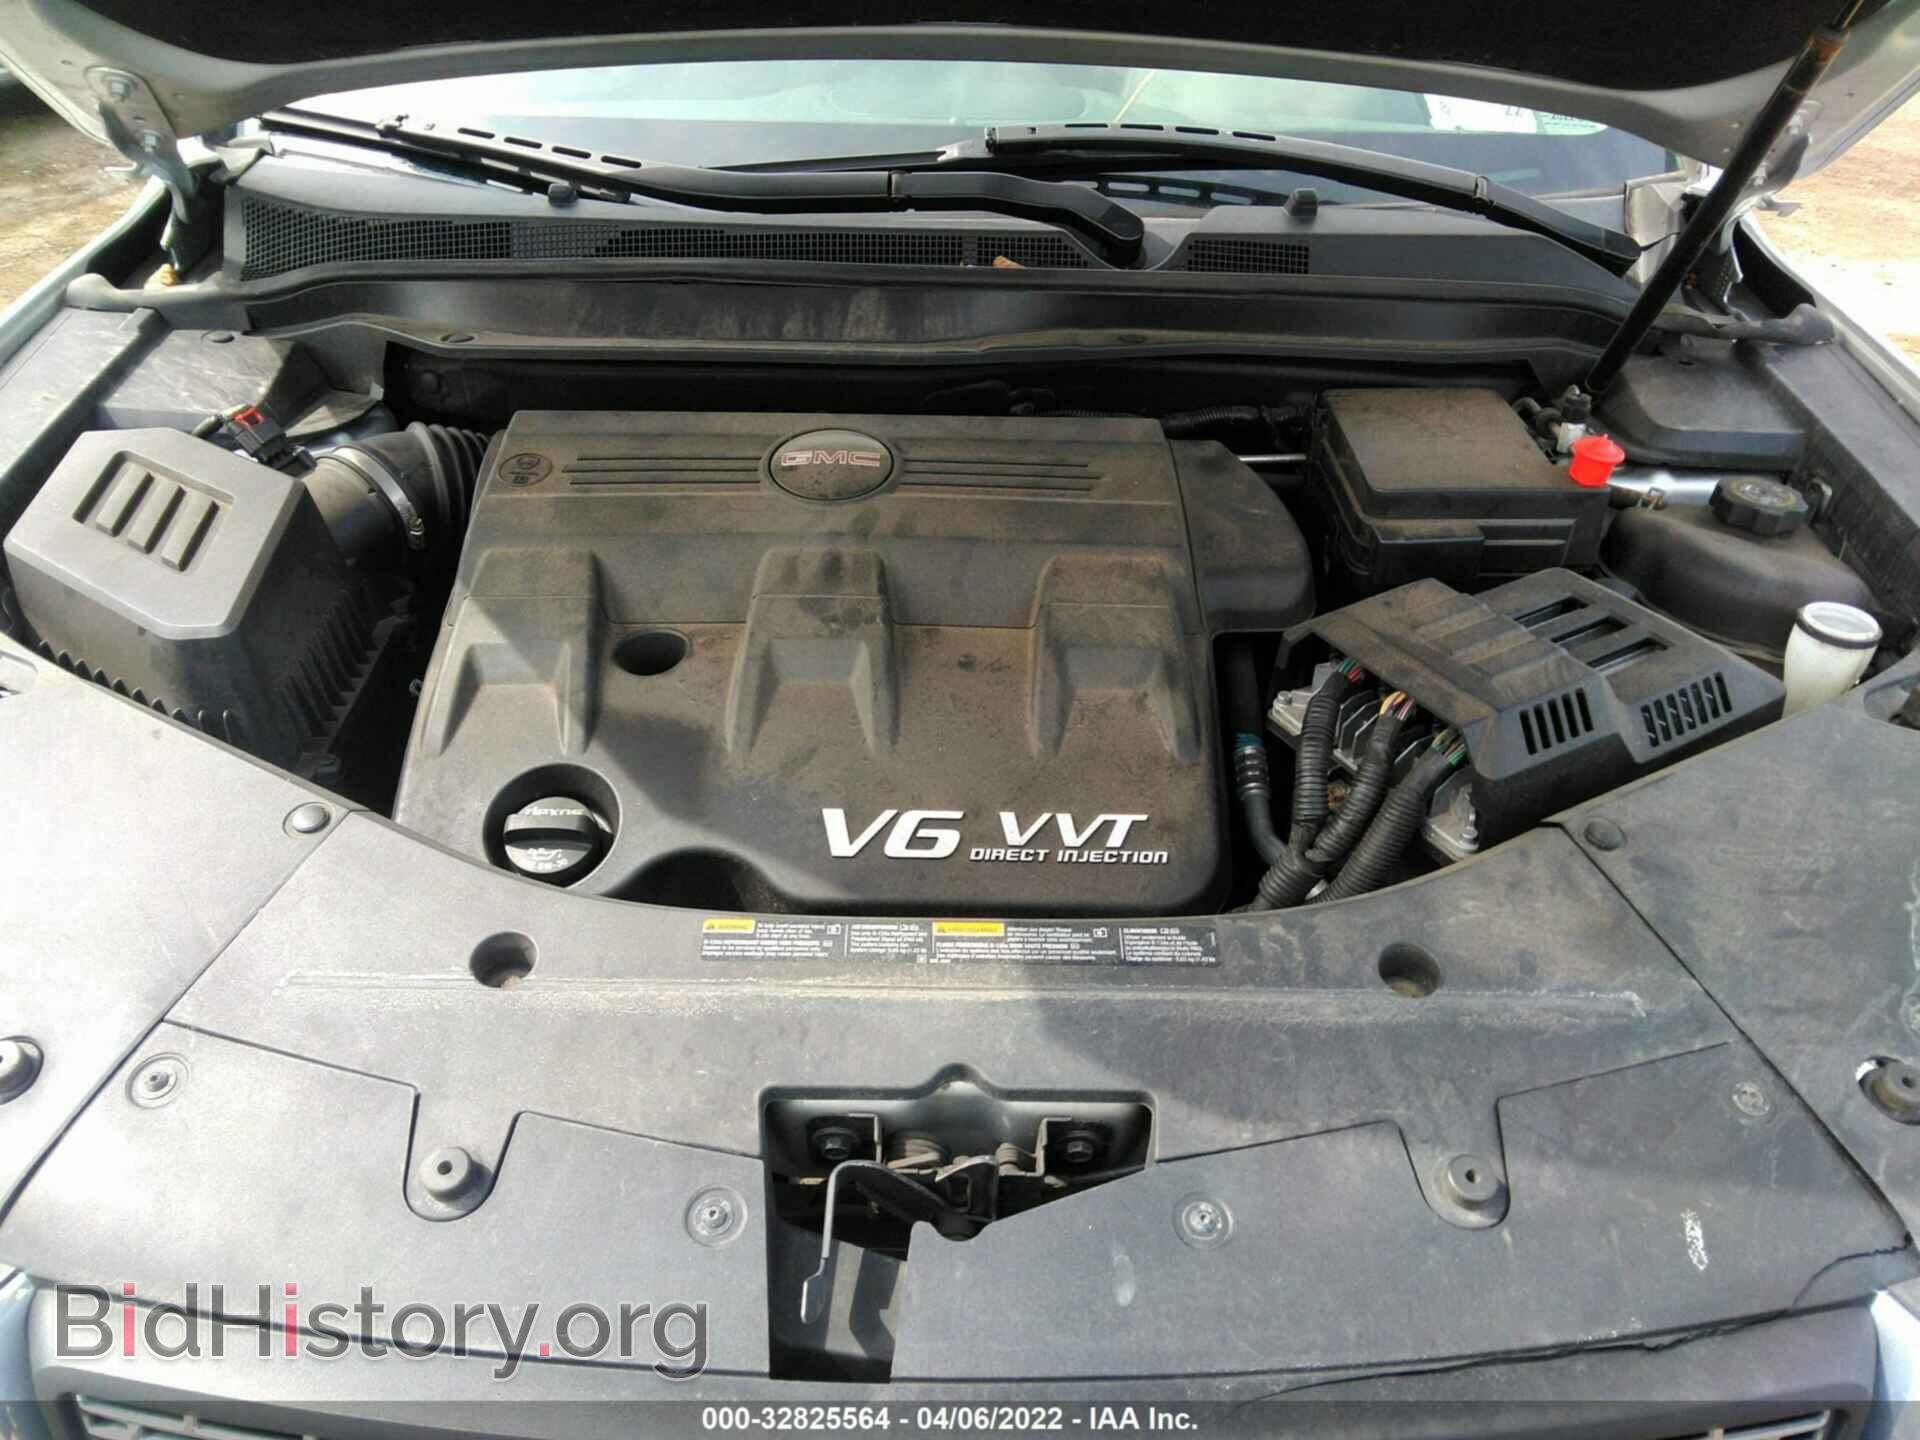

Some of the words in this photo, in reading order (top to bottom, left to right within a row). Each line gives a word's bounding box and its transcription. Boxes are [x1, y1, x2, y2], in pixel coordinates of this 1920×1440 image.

[780, 450, 881, 468] GMC
[821, 808, 965, 859] V6
[998, 811, 1149, 848] VVT
[969, 847, 1049, 862] DIRECT
